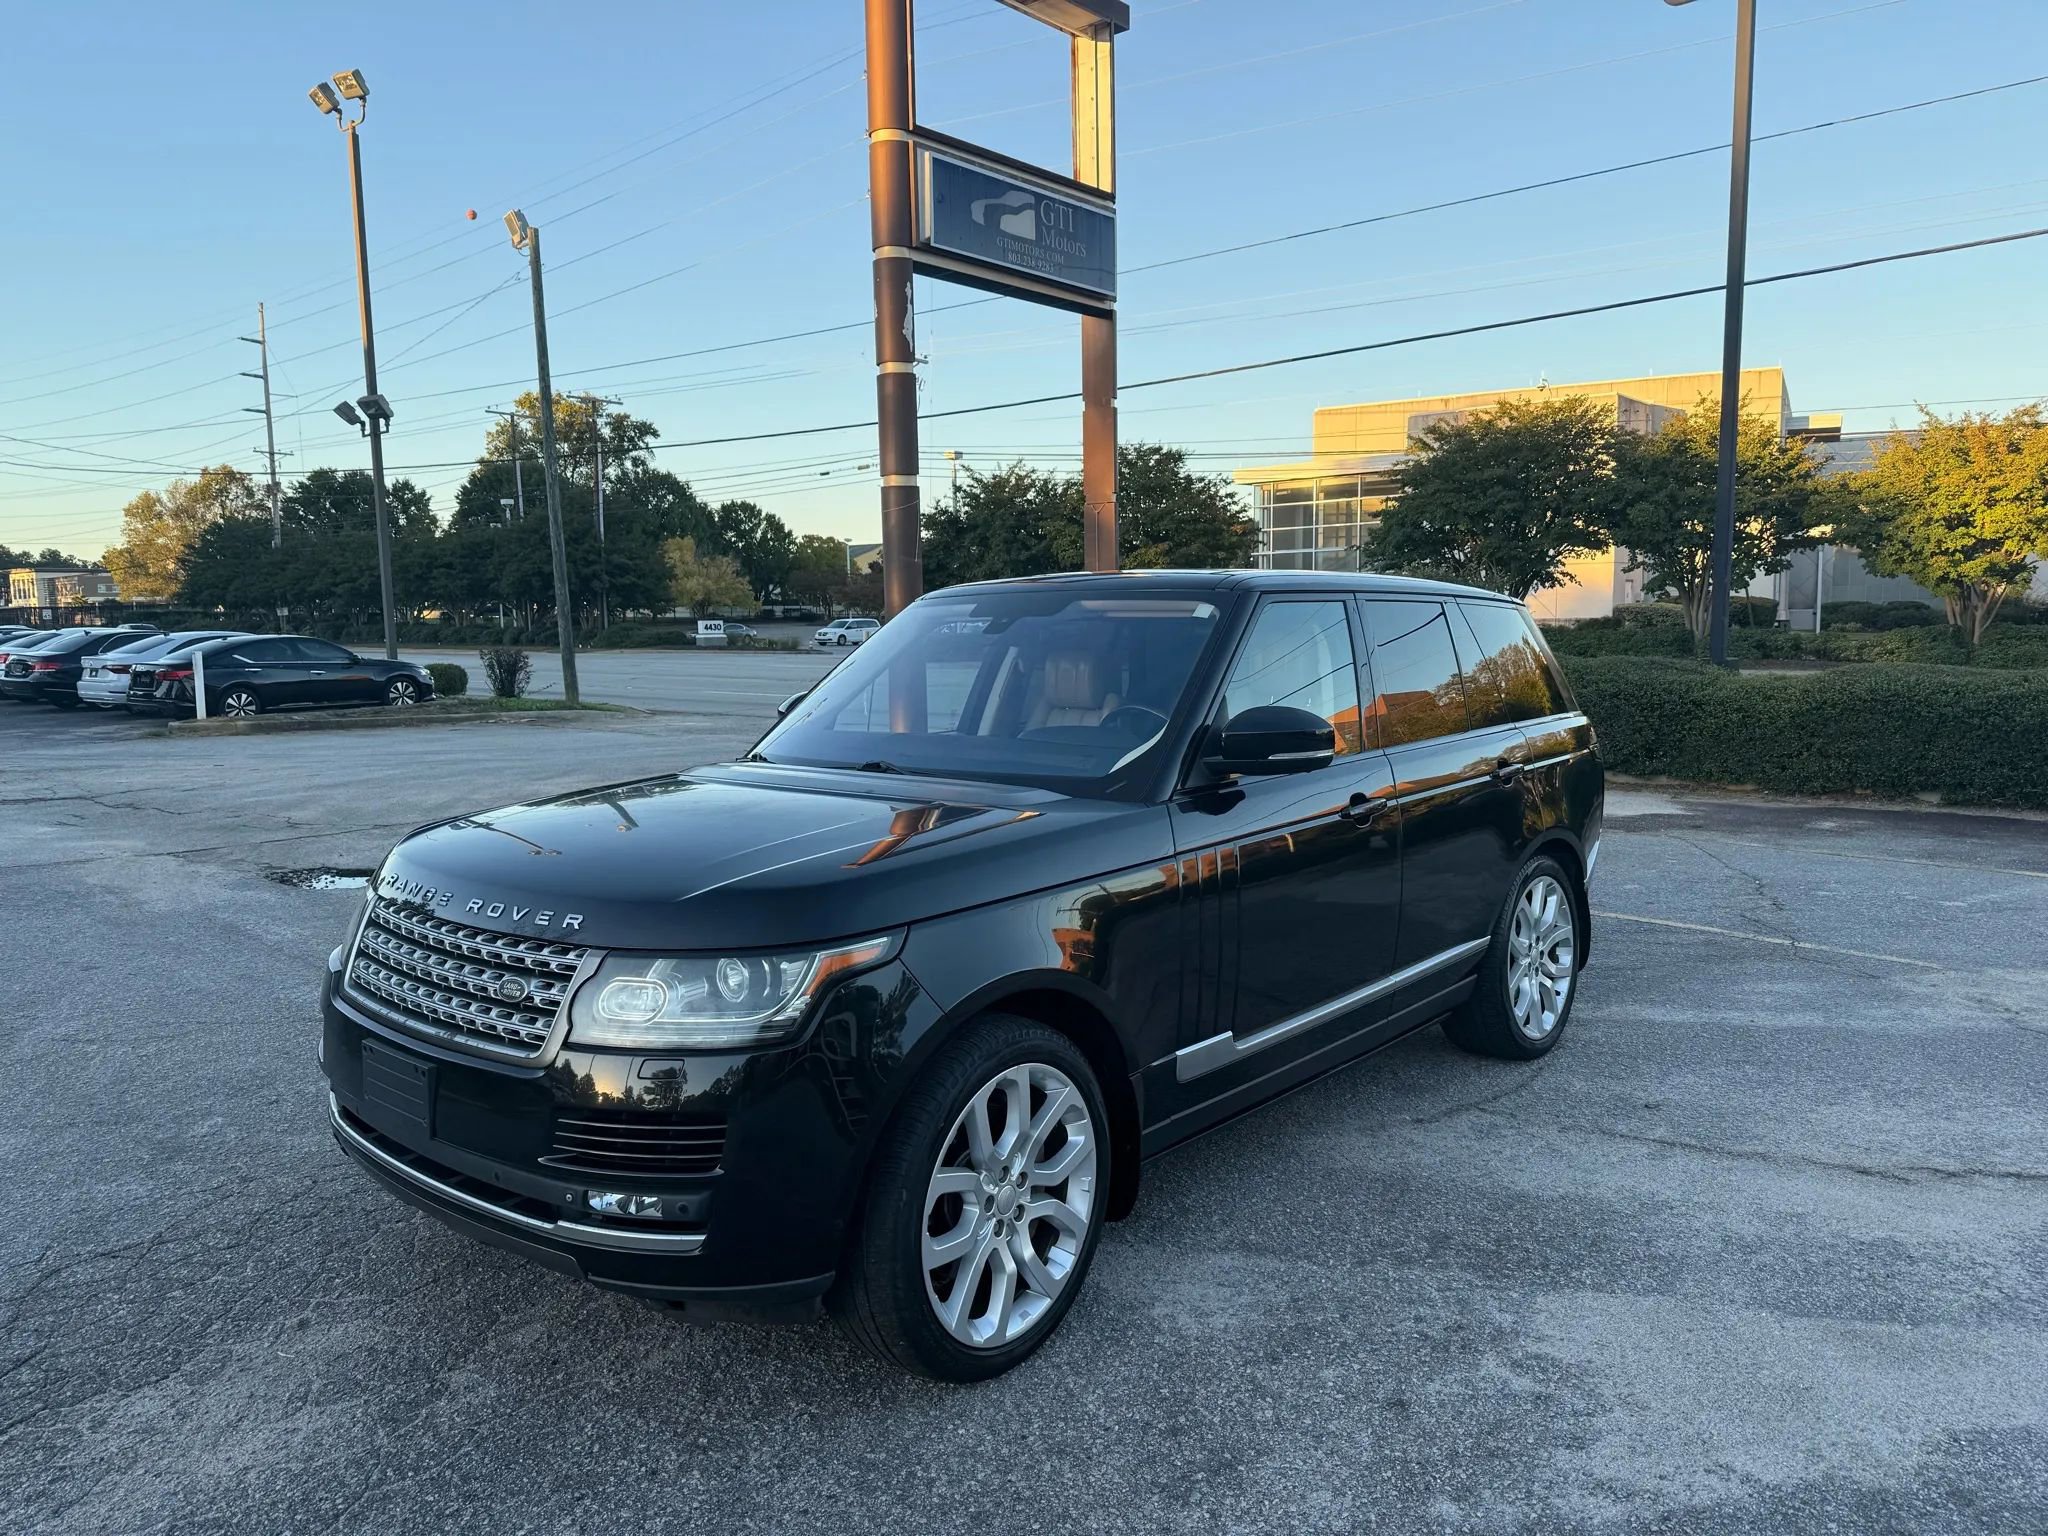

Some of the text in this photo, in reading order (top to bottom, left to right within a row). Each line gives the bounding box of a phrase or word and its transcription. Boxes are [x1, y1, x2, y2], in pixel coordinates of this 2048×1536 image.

[1040, 200, 1074, 232] GTI
[996, 236, 1065, 265] GTIMOTORS.COM
[1042, 226, 1086, 257] Motors
[703, 623, 722, 631] 4430
[386, 872, 584, 930] RANGE ROVER
